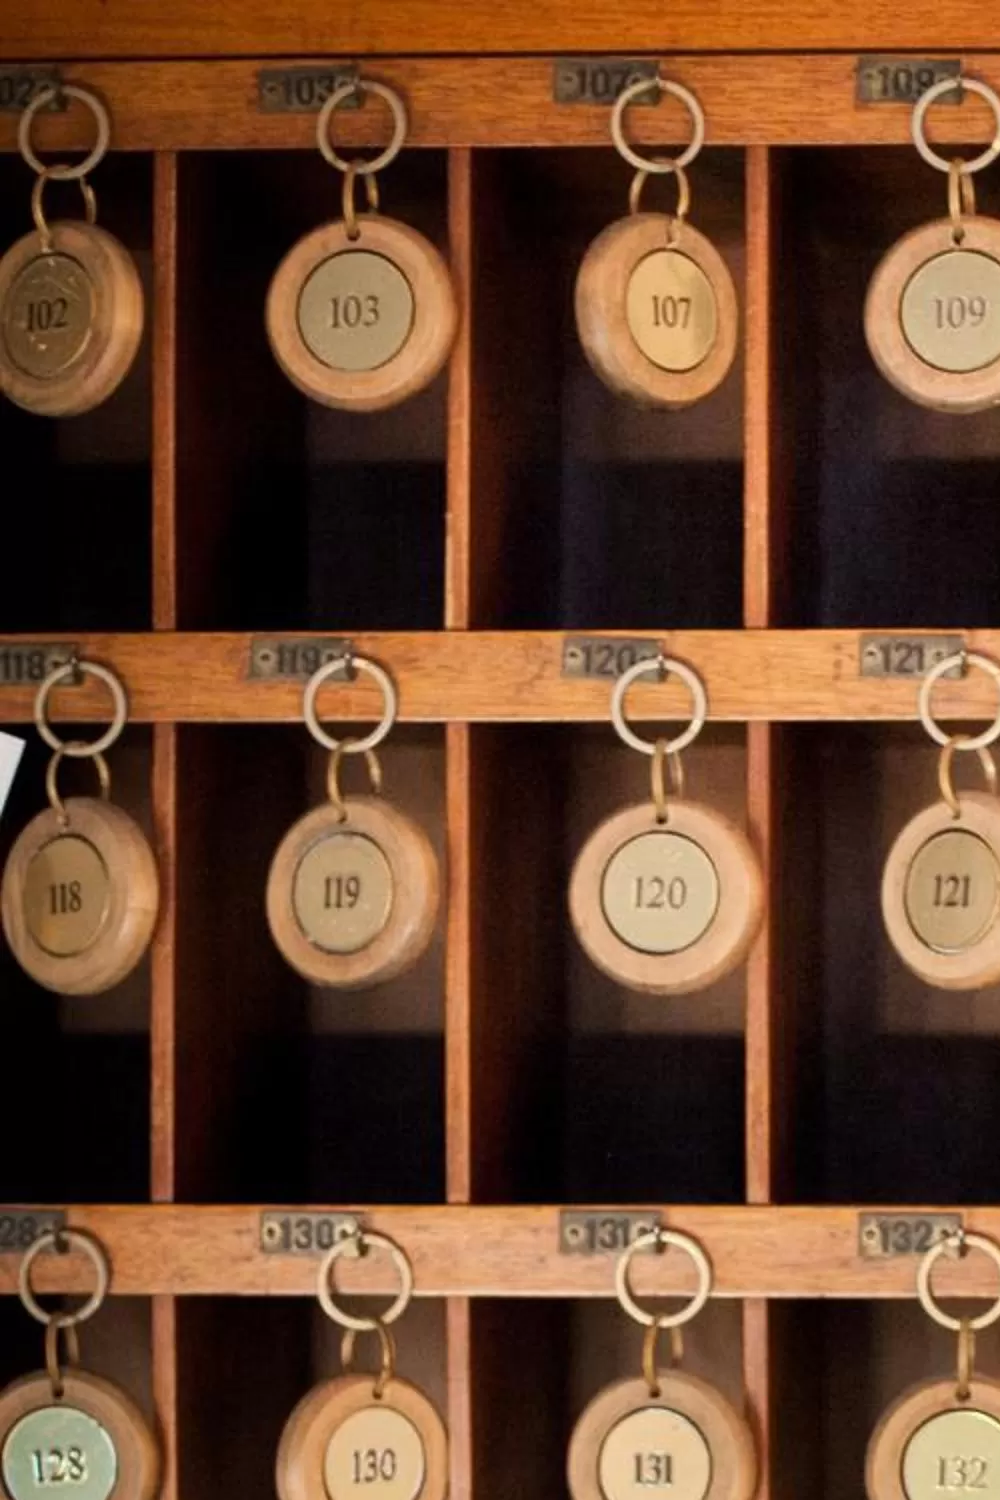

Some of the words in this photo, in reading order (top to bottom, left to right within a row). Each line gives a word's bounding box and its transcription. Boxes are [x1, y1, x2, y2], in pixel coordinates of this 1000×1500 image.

[0, 76, 36, 105] 02
[281, 76, 334, 105] 103
[577, 68, 630, 97] 107
[27, 298, 68, 332] 102
[331, 295, 379, 328] 103
[652, 295, 691, 328] 107
[935, 296, 986, 329] 109
[0, 651, 45, 681] 118
[582, 645, 636, 675] 120
[879, 642, 924, 672] 121
[49, 880, 82, 915] 118
[324, 876, 360, 908] 119
[635, 876, 687, 909] 120
[933, 875, 970, 907] 121
[0, 1216, 37, 1247] 28
[280, 1218, 334, 1250] 130
[587, 1218, 629, 1249] 131
[880, 1221, 933, 1253] 132
[33, 1447, 84, 1482] 128
[353, 1448, 396, 1484] 130
[635, 1453, 673, 1484] 131
[938, 1456, 987, 1488] 132
